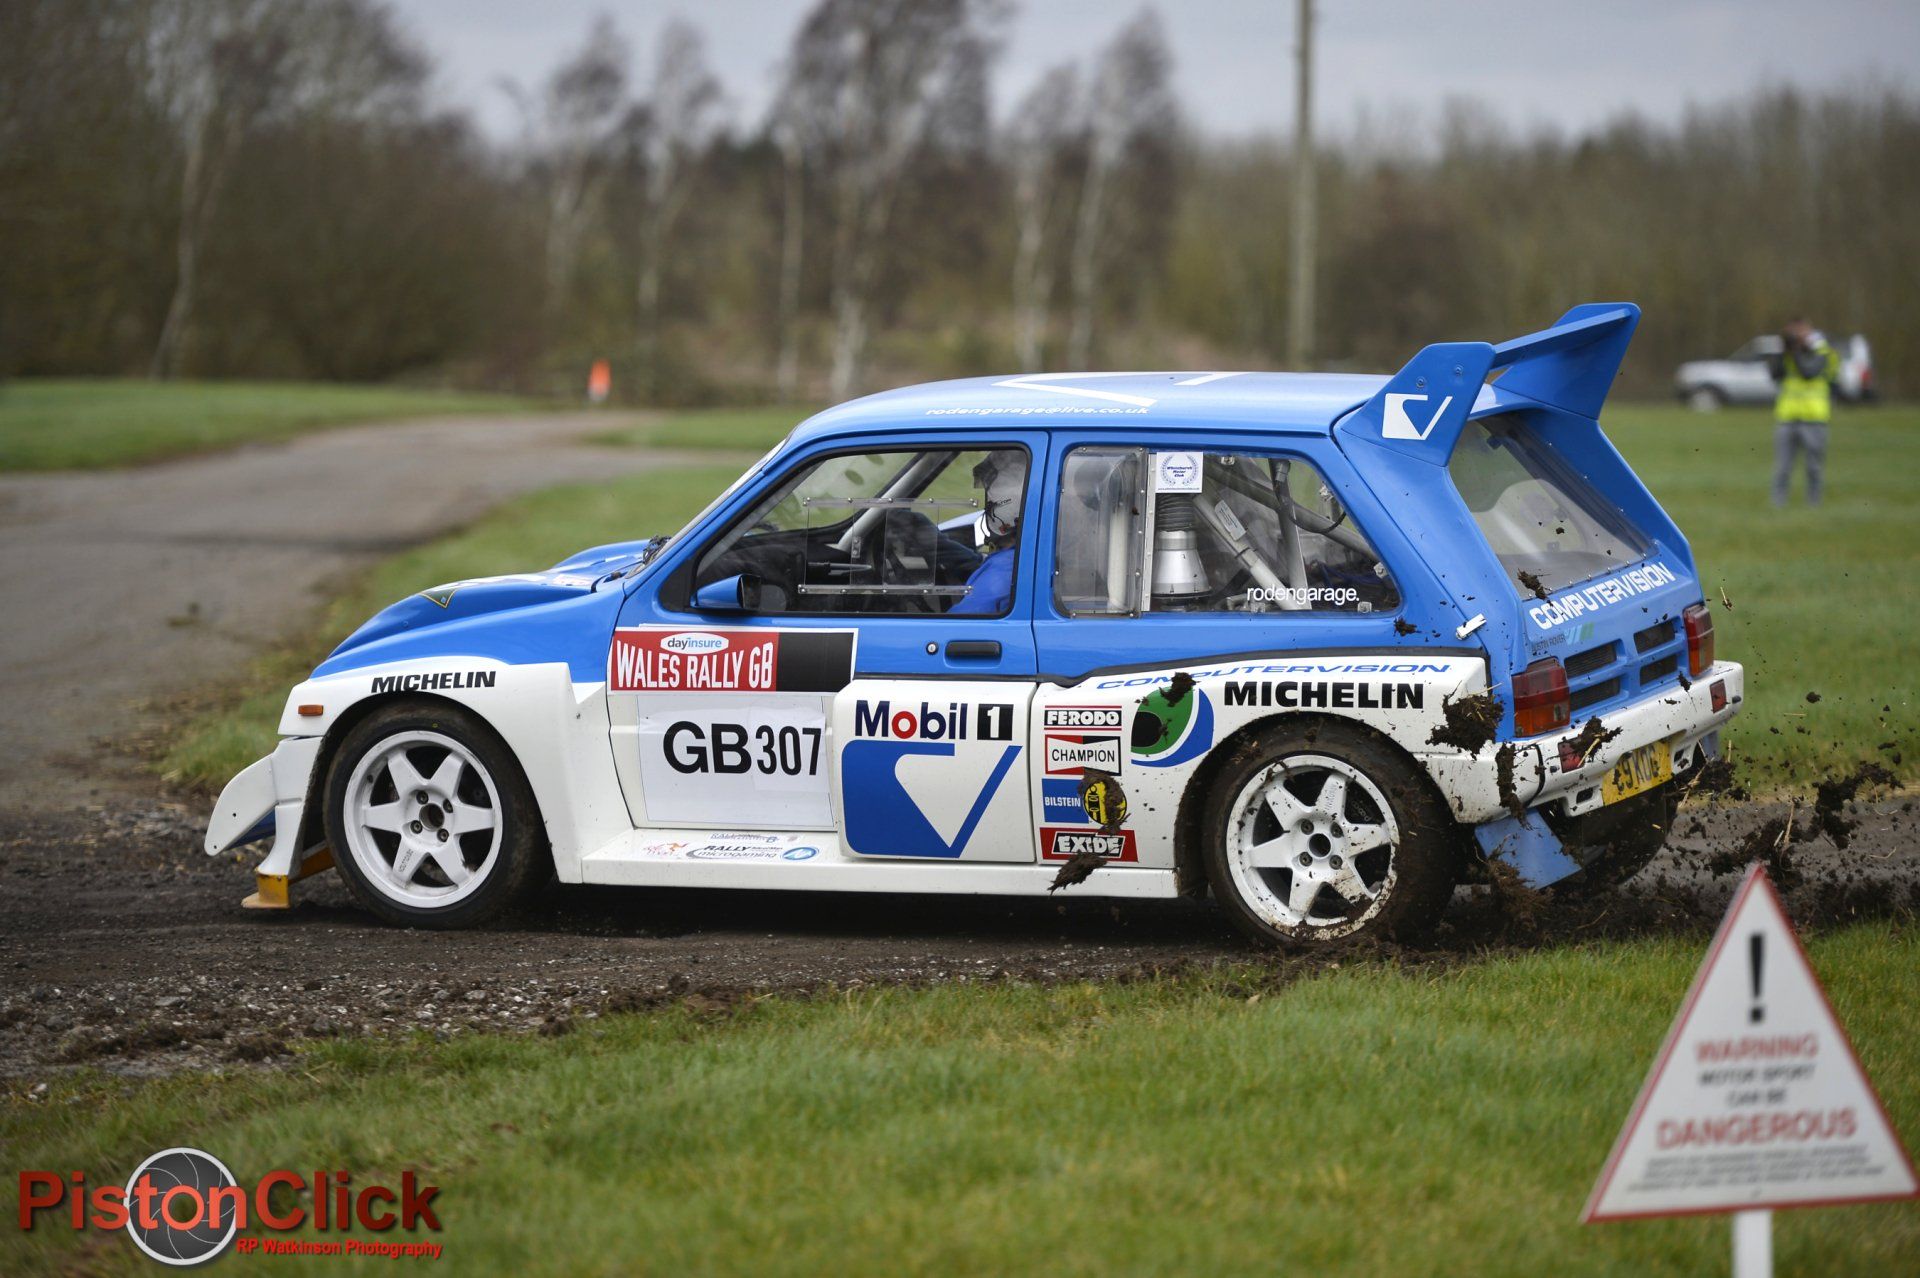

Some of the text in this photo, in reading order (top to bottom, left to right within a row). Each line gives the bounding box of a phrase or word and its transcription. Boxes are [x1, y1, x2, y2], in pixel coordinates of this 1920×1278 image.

[926, 406, 1149, 416] rodengarage@live.co.uk
[1529, 562, 1676, 630] COMPUTERVISION
[667, 637, 722, 650] dayinsure
[616, 640, 774, 689] WALES RALLY GB
[371, 671, 496, 693] MICHELIN
[1224, 681, 1424, 709] MICHELIN
[855, 700, 966, 740] Mobil
[1047, 710, 1119, 726] FERODO
[1052, 749, 1115, 762] CHAMPION
[1044, 796, 1081, 807] BILSTEIN
[1057, 835, 1120, 854] EXIDE
[1695, 1032, 1818, 1062] WARNING
[1656, 1106, 1858, 1150] DANGEROUS
